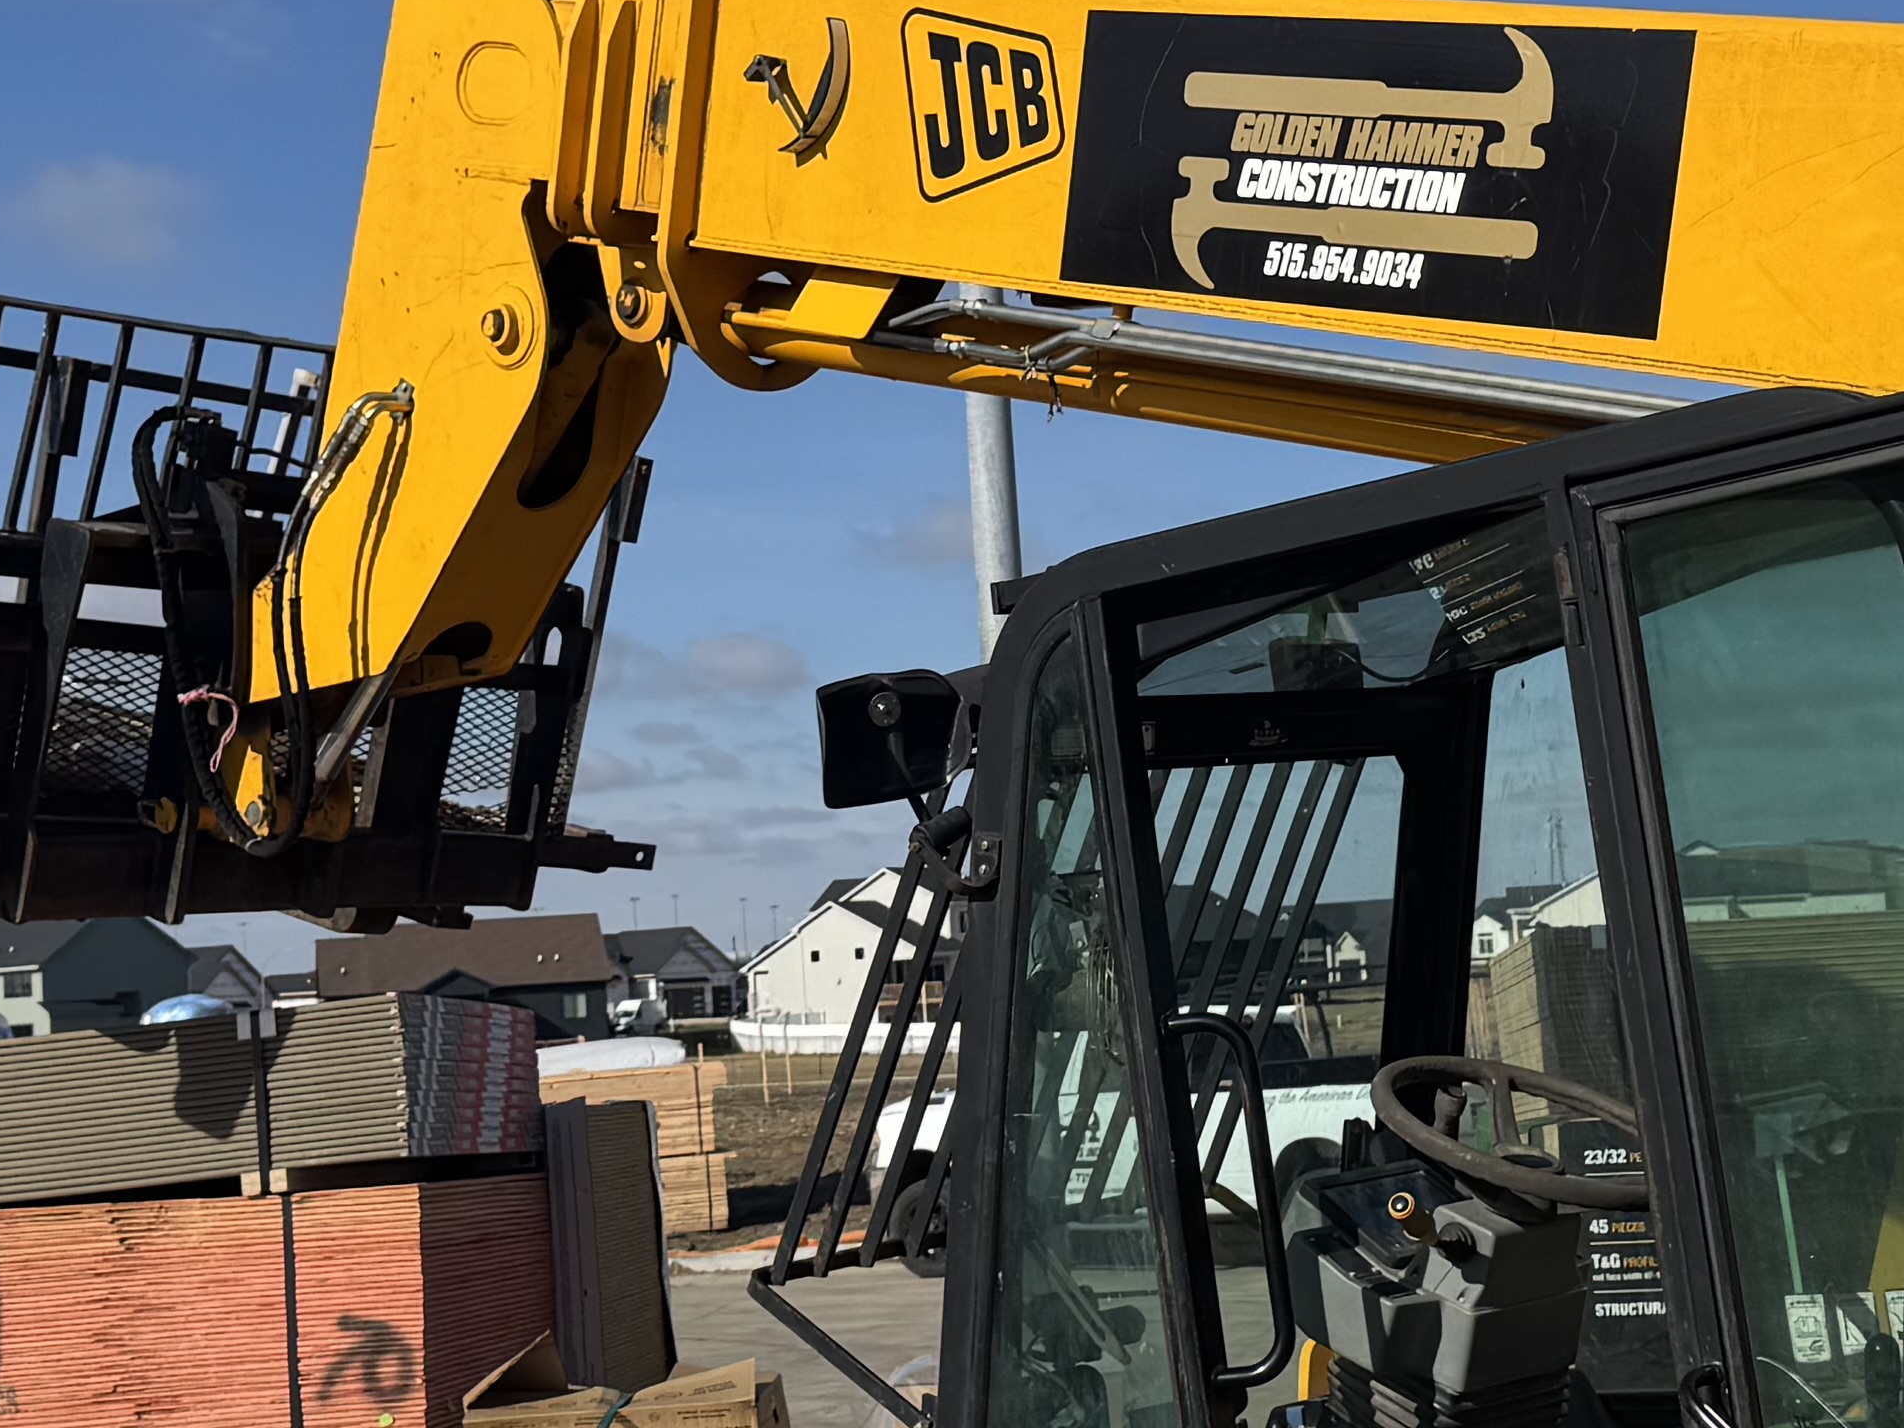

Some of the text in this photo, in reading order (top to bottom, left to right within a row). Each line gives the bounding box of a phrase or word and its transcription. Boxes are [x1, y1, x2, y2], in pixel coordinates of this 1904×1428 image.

[924, 30, 1049, 180] JCB
[1231, 112, 1484, 168] GOLDEN HAMMER
[1236, 158, 1467, 214] CONSTRUCTION
[1263, 240, 1425, 290] 515.954.9034
[1584, 1149, 1627, 1165] 23/32
[1589, 1219, 1609, 1234] 45
[1591, 1253, 1621, 1269] T&G
